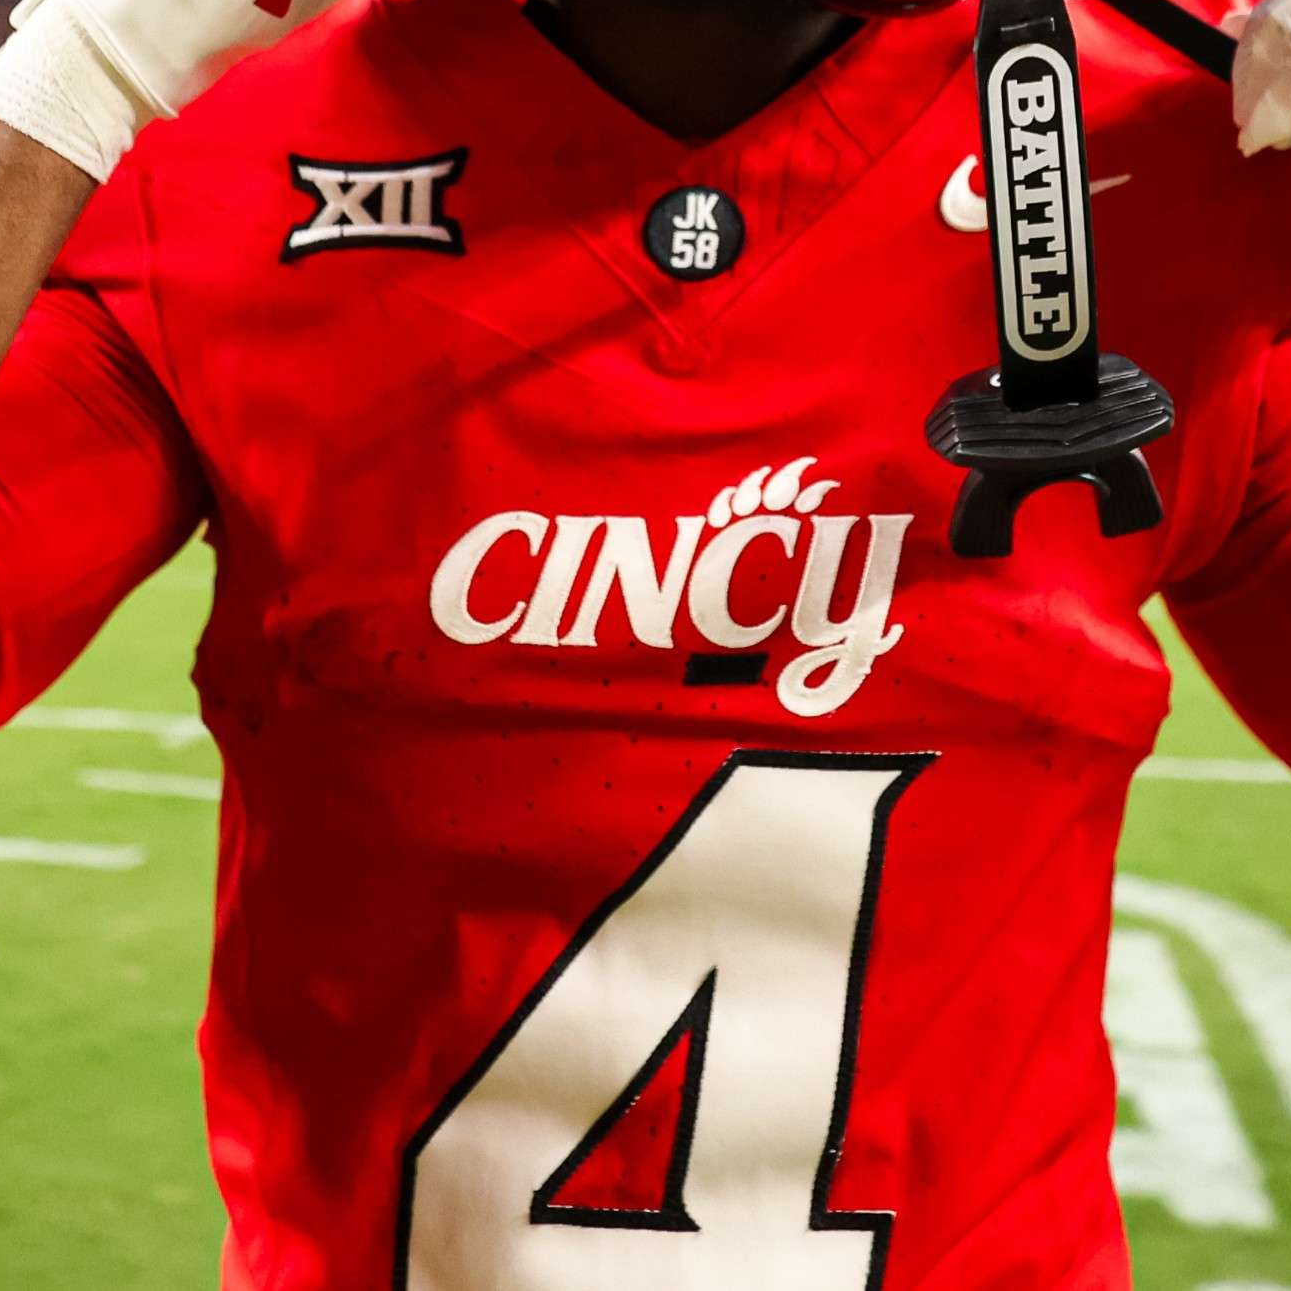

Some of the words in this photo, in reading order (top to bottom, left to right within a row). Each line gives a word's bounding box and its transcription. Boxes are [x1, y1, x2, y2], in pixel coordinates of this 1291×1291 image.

[288, 160, 456, 249] XII
[673, 192, 720, 231] JK
[1006, 74, 1071, 336] BATTLE
[669, 231, 719, 270] 58
[393, 748, 940, 1291] 4
